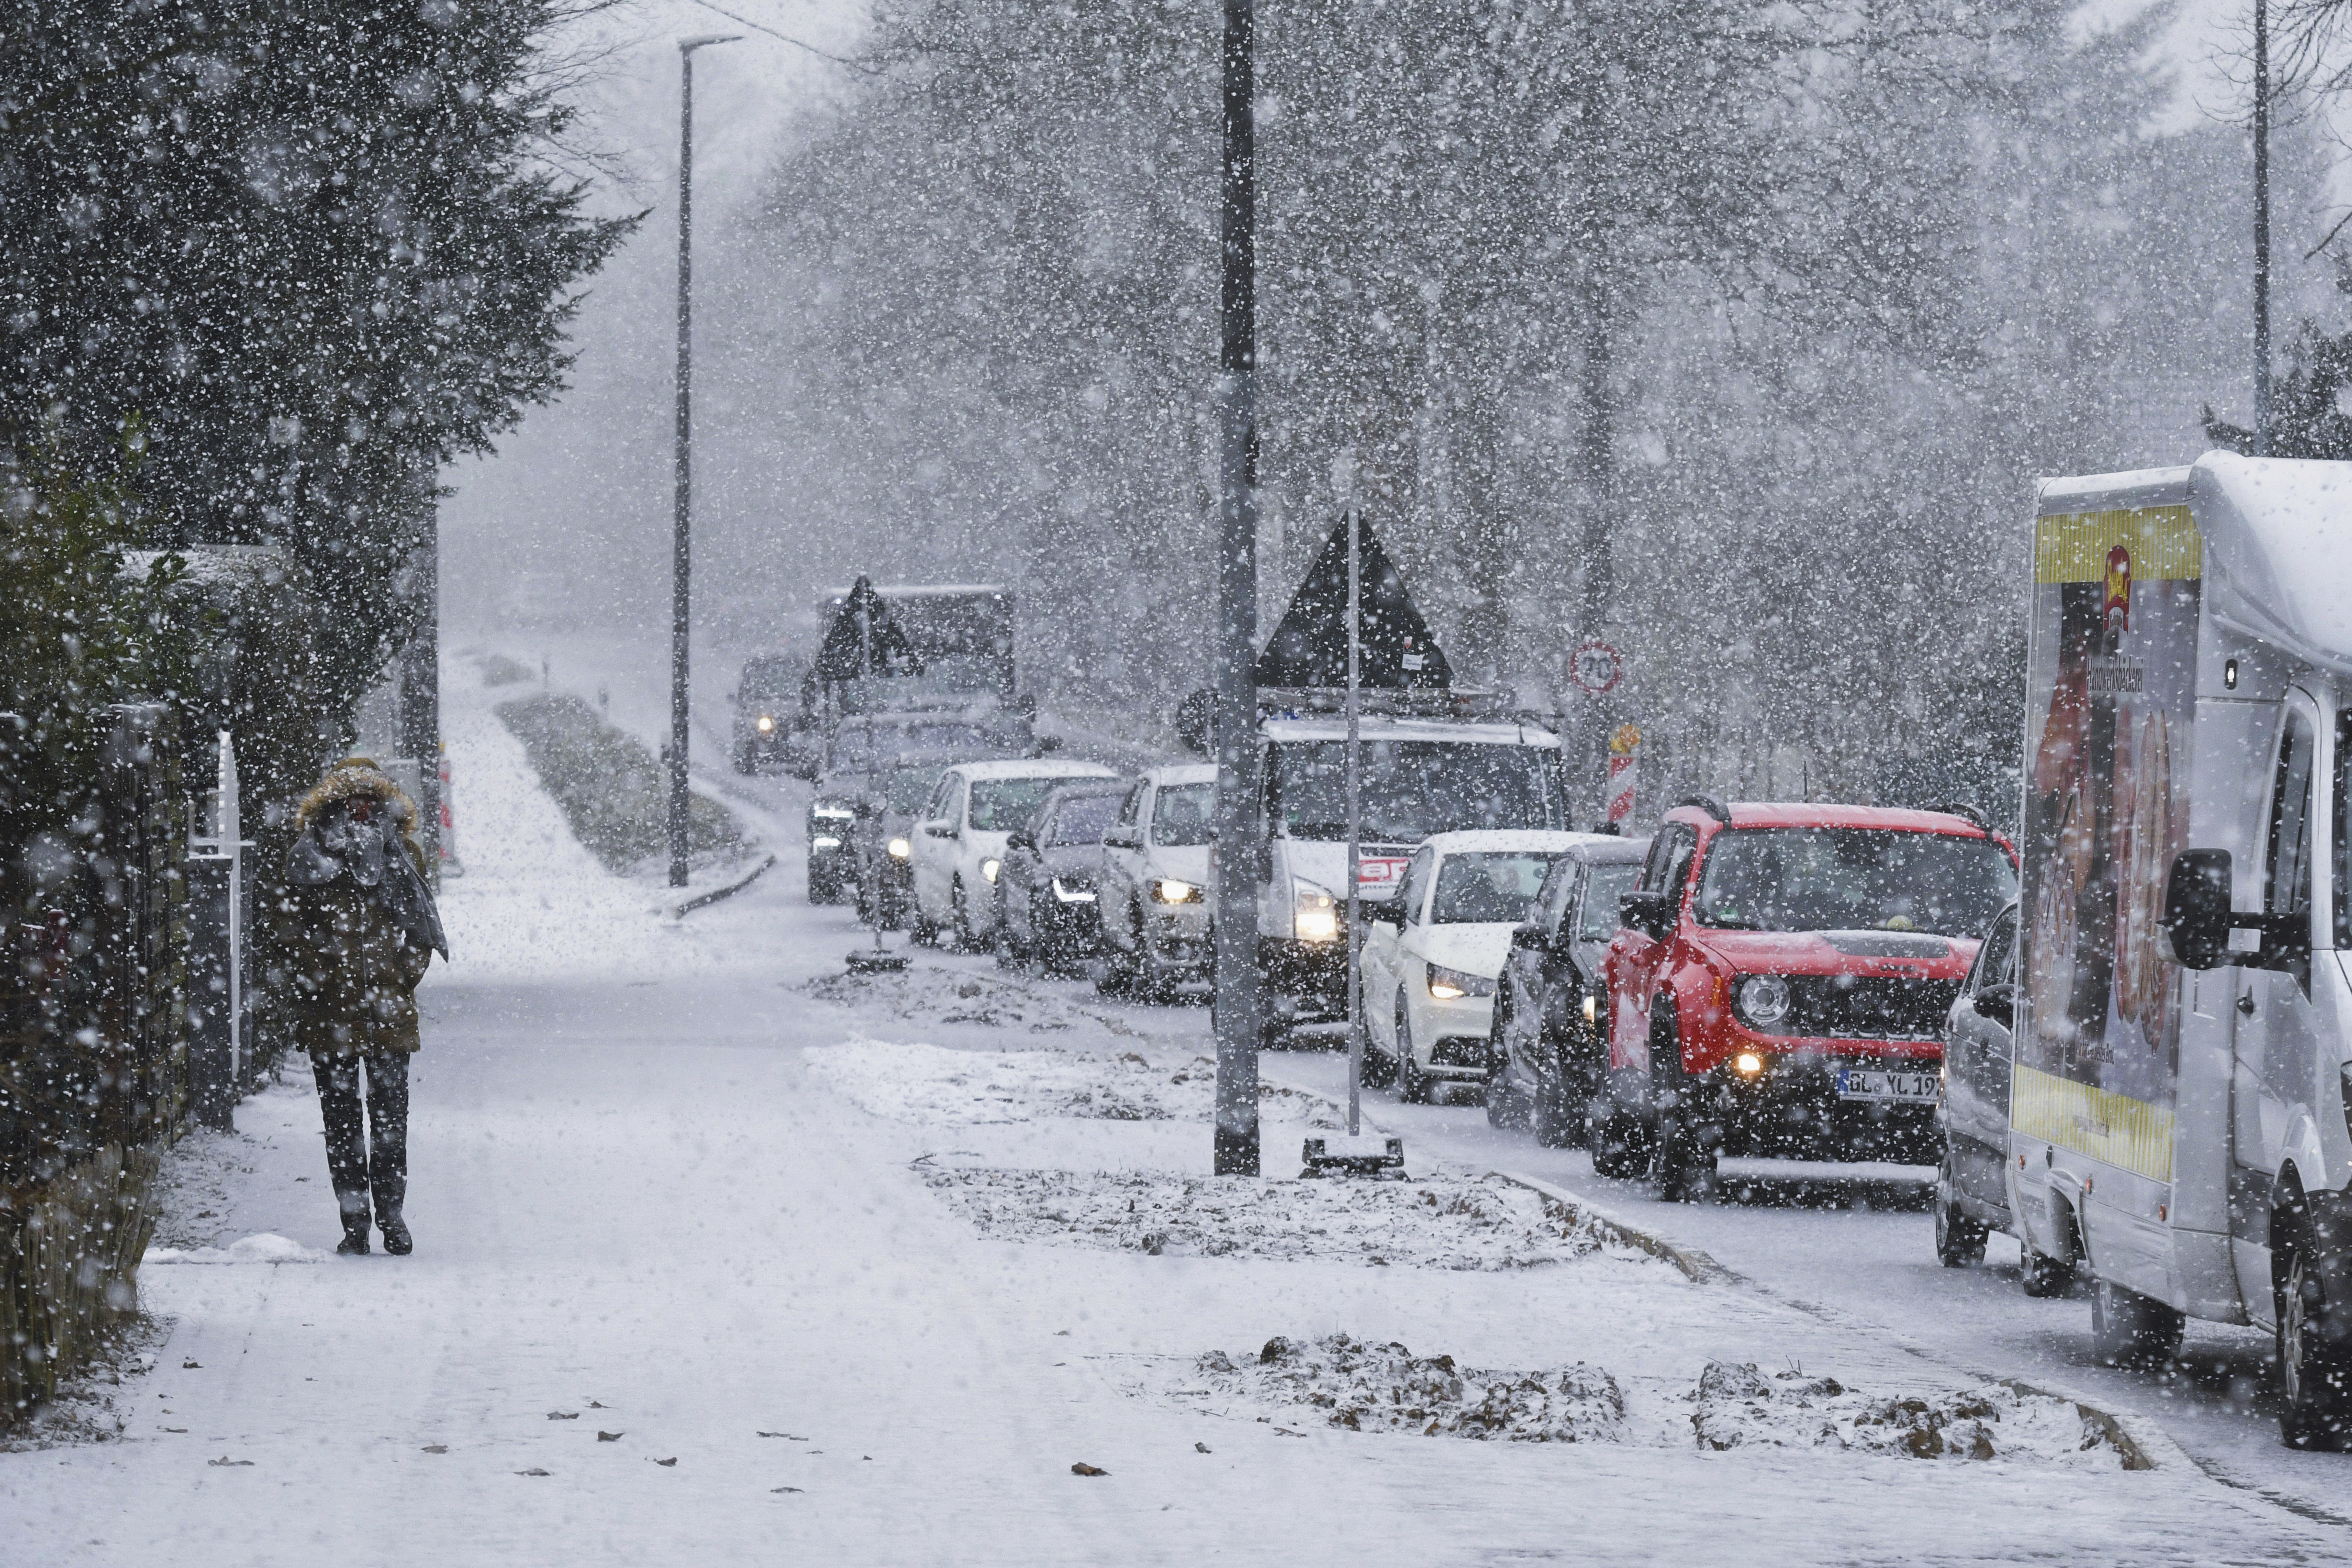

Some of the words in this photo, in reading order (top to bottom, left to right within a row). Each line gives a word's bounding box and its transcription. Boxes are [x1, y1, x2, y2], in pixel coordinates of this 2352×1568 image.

[2087, 655, 2143, 692] Handwerksbäckerei
[1850, 1074, 1872, 1092] GL
[1886, 1075, 1907, 1095] XL
